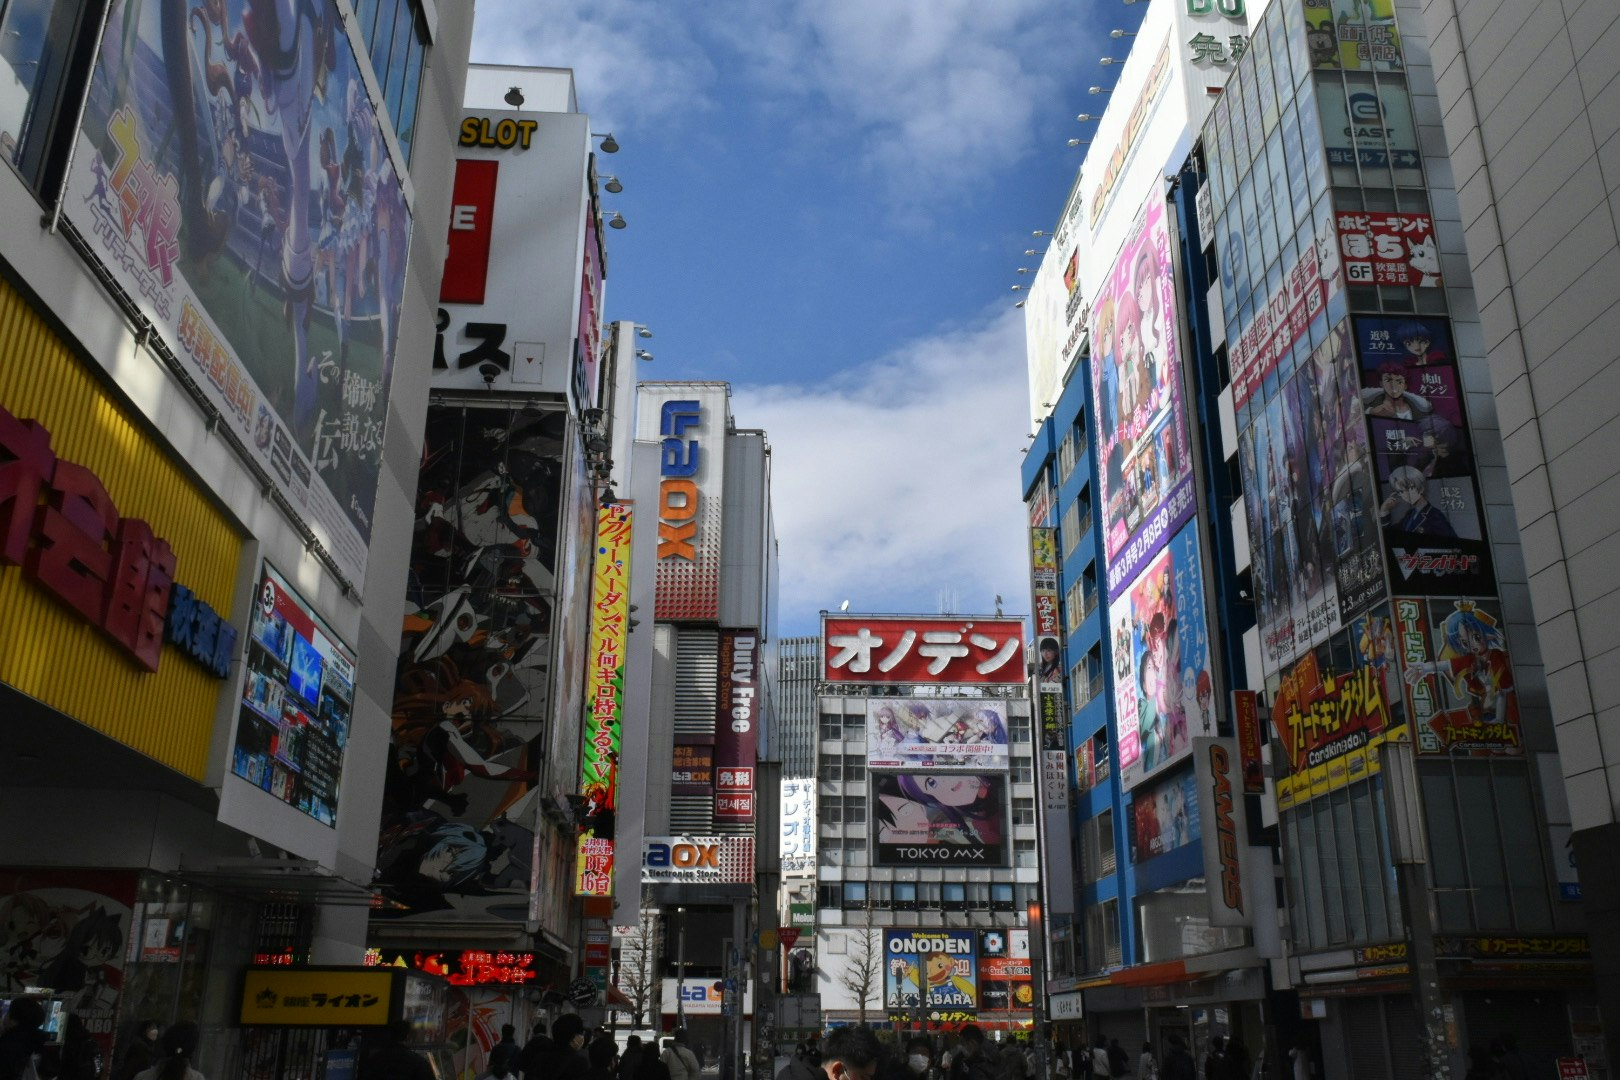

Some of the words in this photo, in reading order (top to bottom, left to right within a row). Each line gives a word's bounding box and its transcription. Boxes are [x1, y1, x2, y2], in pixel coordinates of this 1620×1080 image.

[460, 116, 538, 149] SLOT
[1337, 213, 1430, 233] ホビーランド
[1349, 264, 1371, 280] 6F
[719, 636, 732, 679] Flagship
[828, 622, 1020, 676] オノデン
[720, 680, 732, 711] Store
[732, 687, 755, 734] Free
[720, 771, 751, 786] 免税
[717, 798, 751, 811] 면세점
[896, 847, 950, 859] TOKYO
[953, 848, 985, 859] MX
[579, 871, 610, 893] 16台
[648, 868, 694, 878] Electronics
[696, 869, 719, 879] Store
[889, 937, 971, 954] ONODEN
[311, 992, 380, 1008] ライオン
